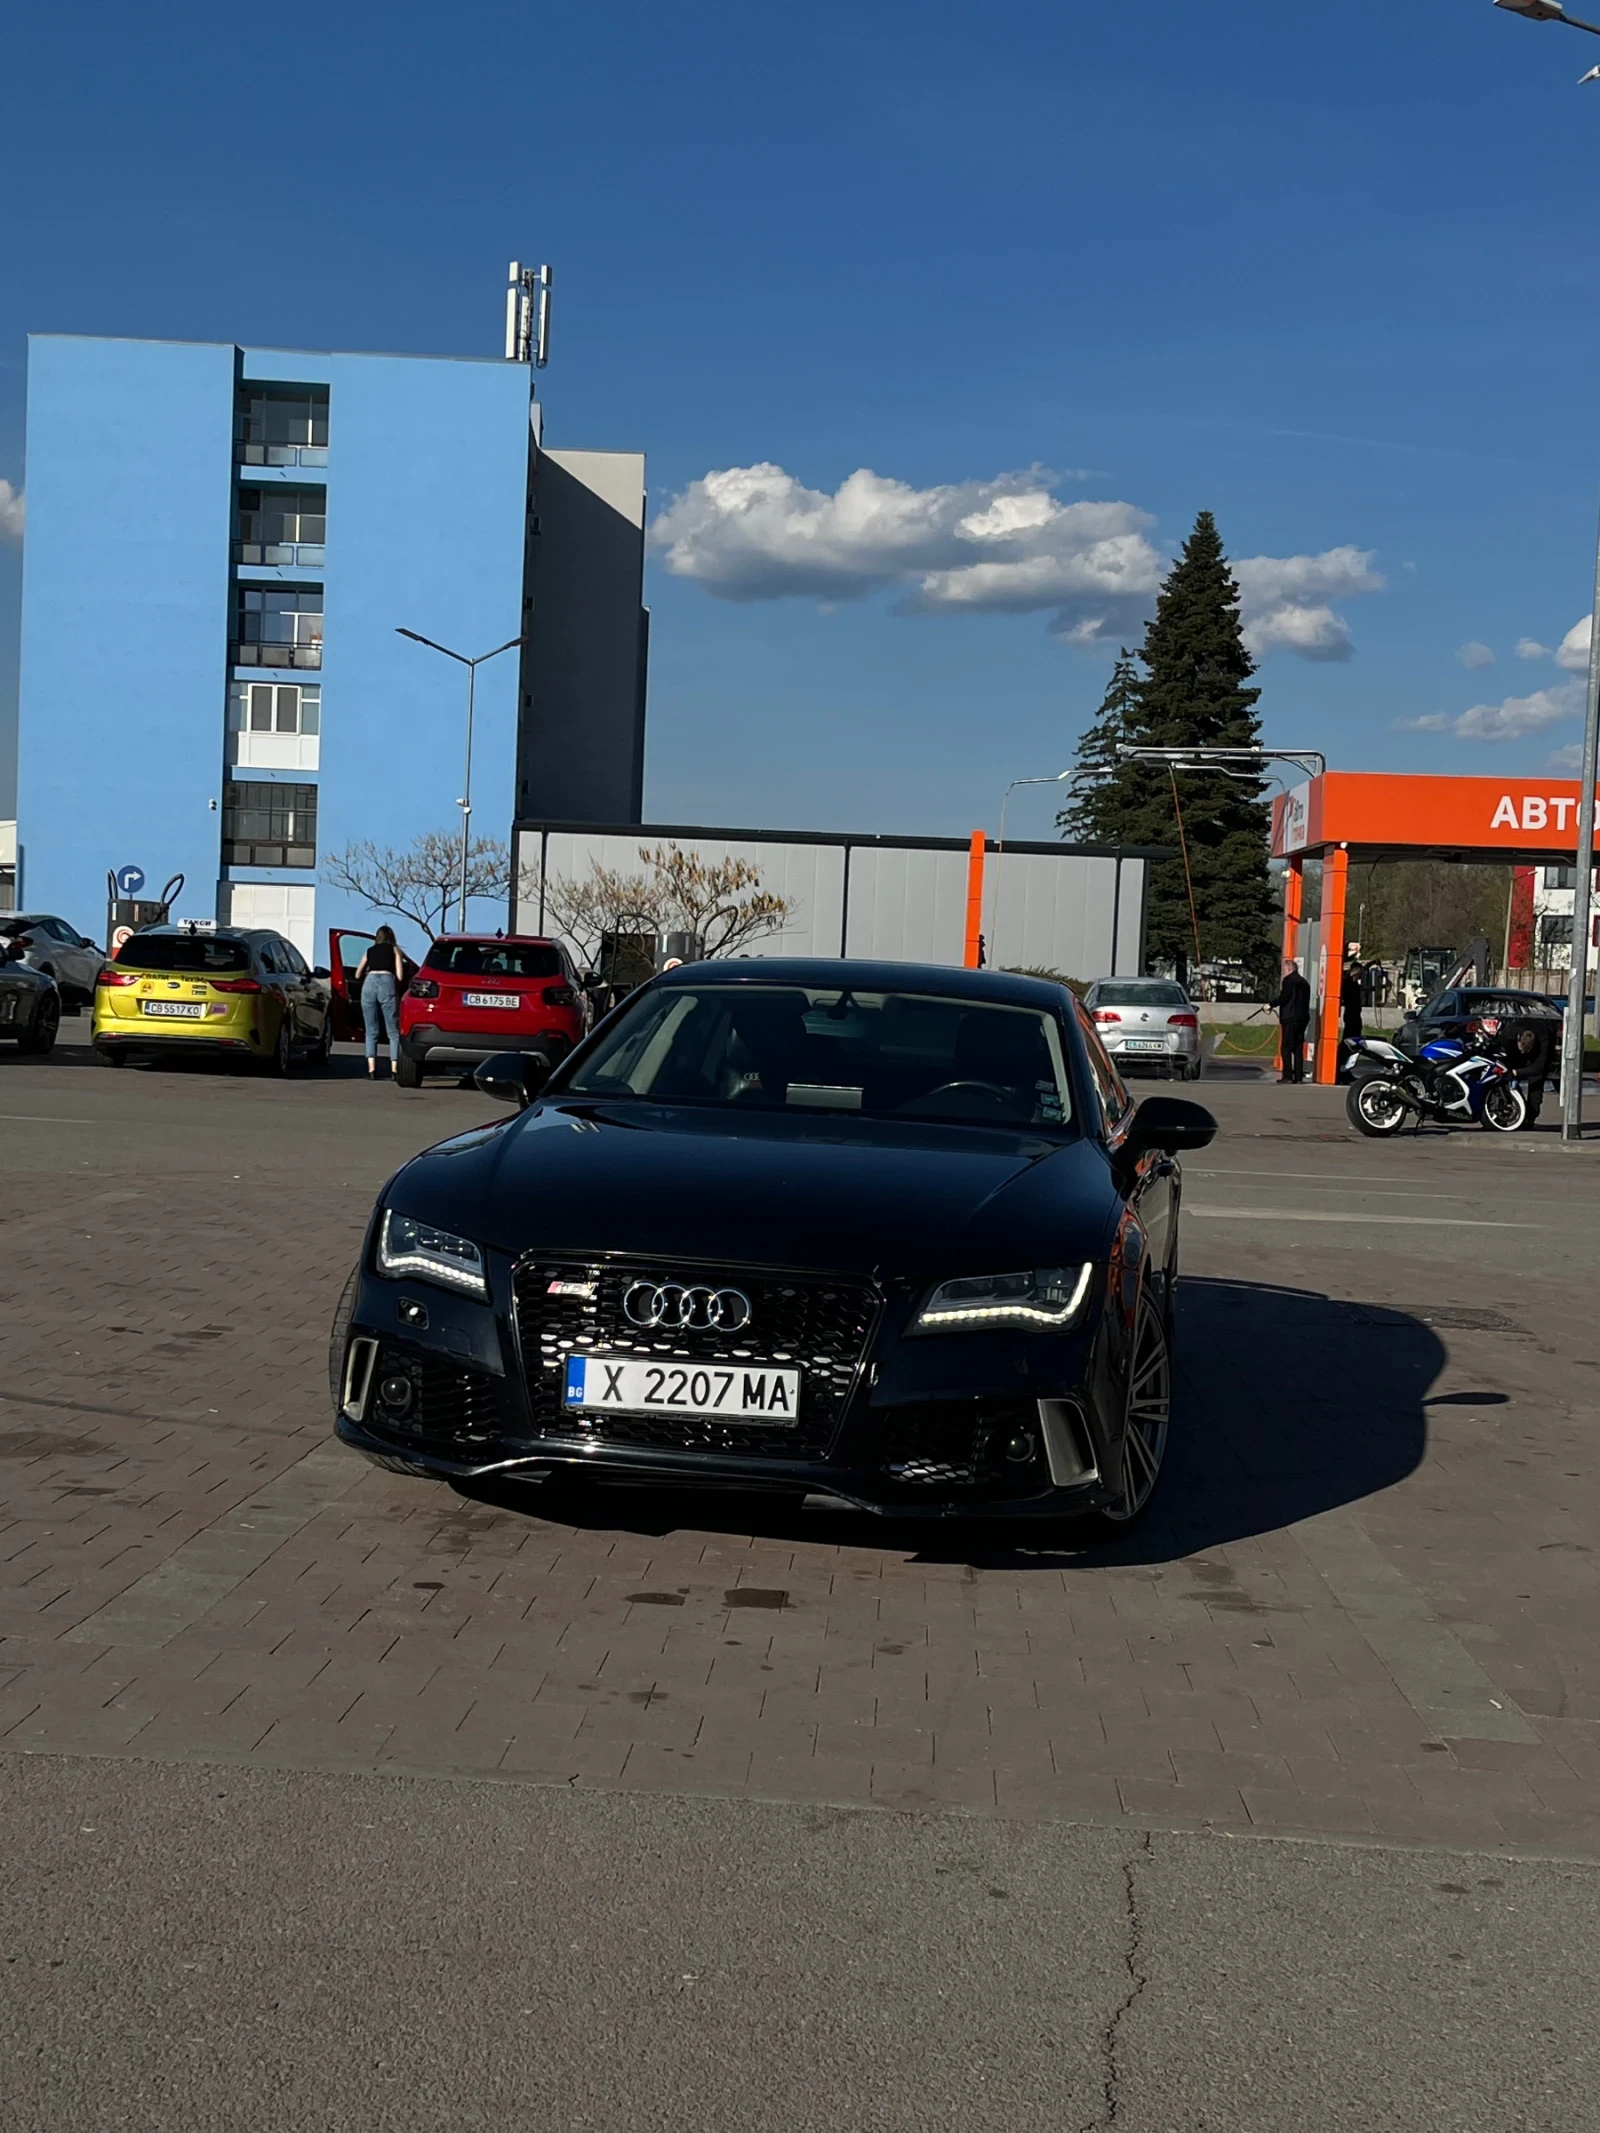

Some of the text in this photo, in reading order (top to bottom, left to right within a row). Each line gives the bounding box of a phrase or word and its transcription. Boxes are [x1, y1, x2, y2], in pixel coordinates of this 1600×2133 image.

[183, 919, 212, 927] ТАКСИ
[482, 996, 504, 1006] 6175
[505, 998, 518, 1007] BE
[164, 1004, 186, 1015] 5517
[567, 1386, 584, 1398] BG
[602, 1364, 790, 1412] X 2207 MA
